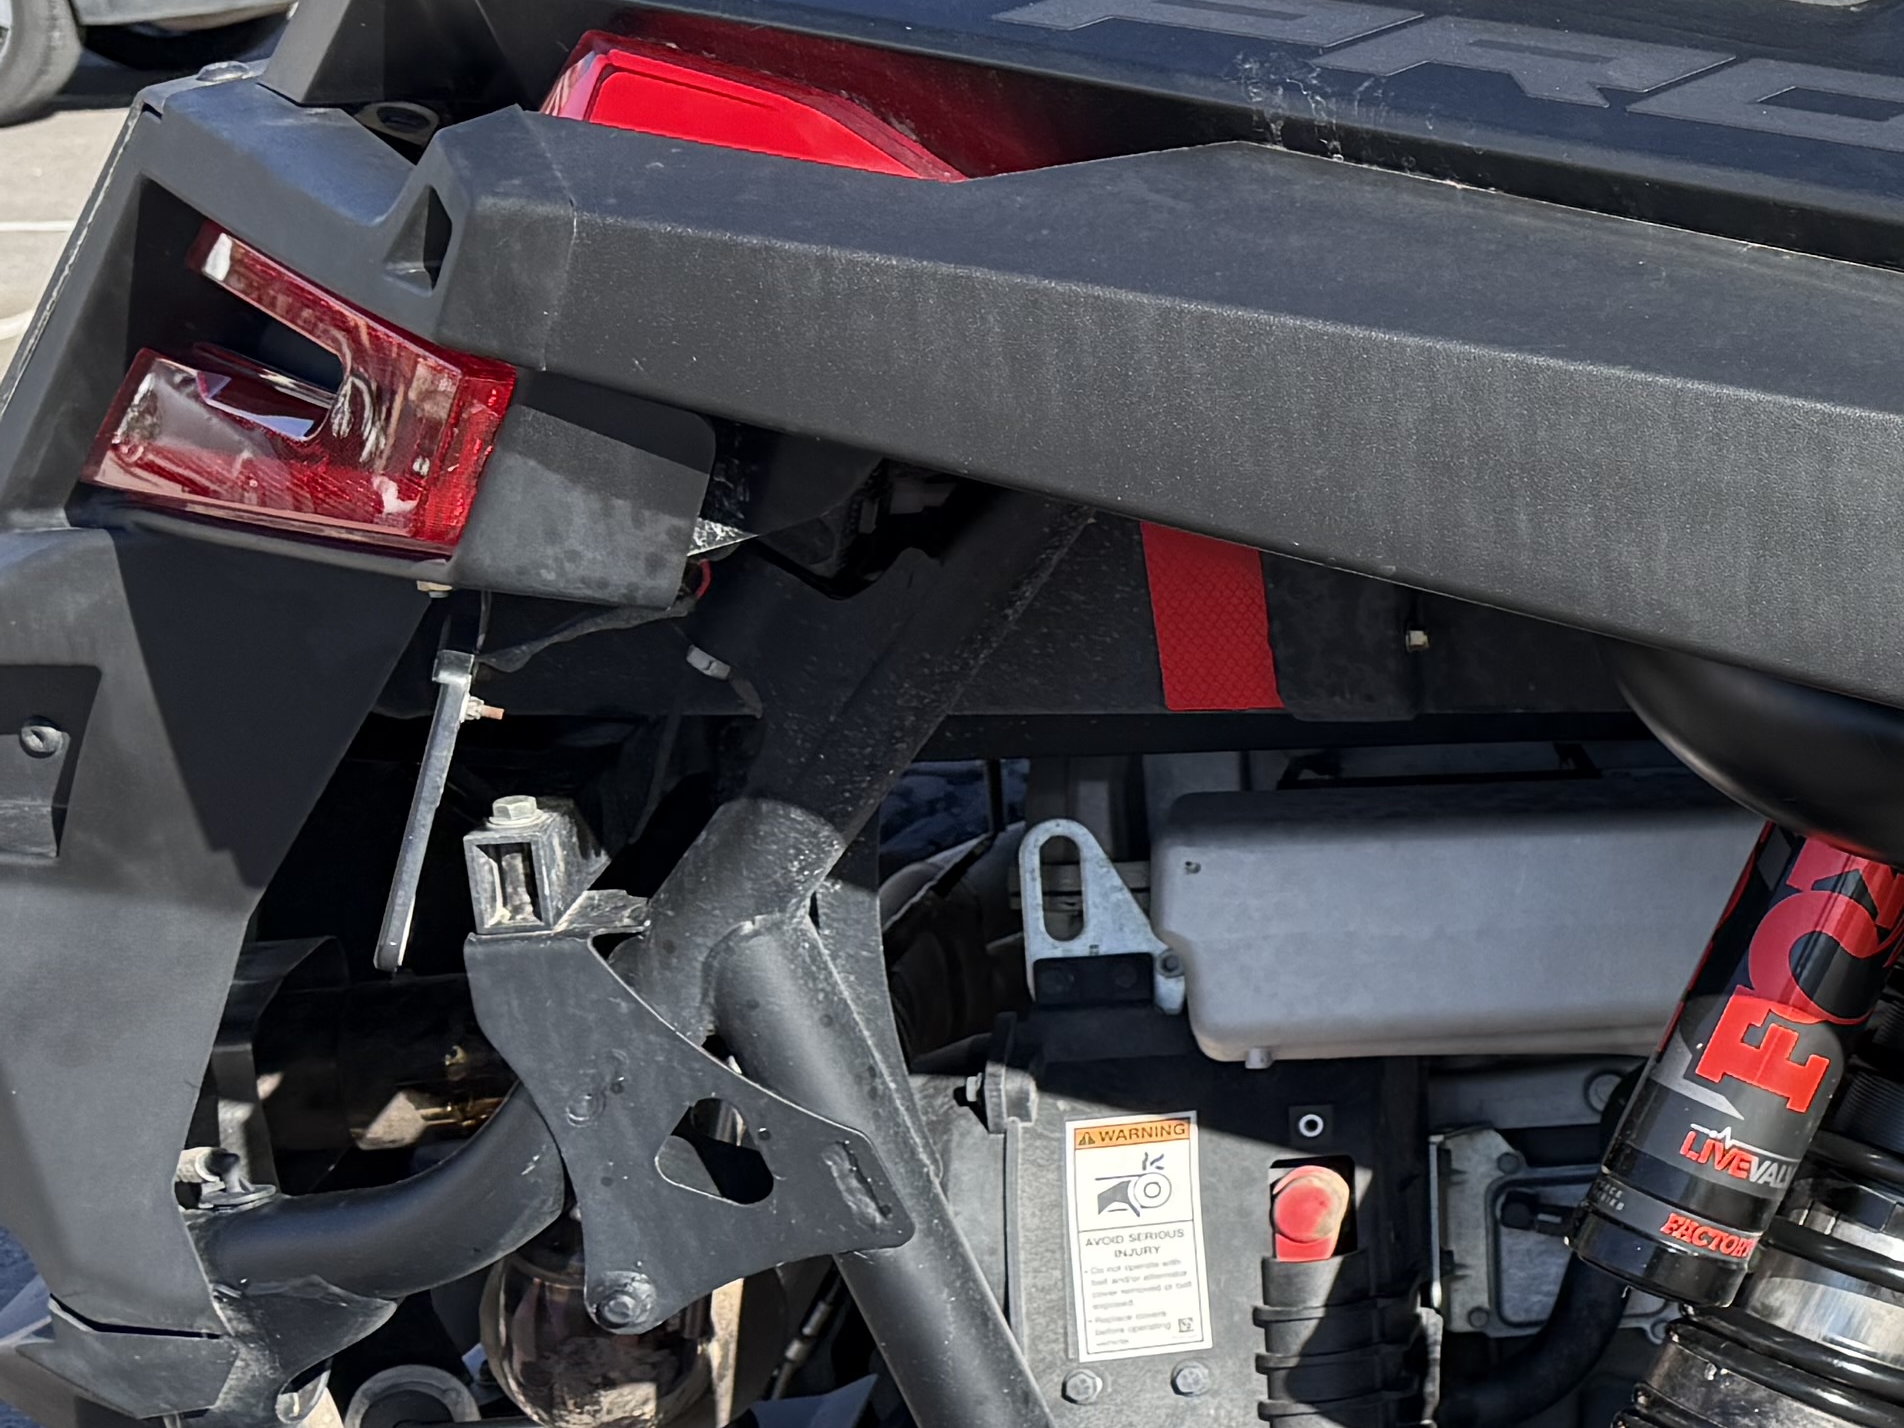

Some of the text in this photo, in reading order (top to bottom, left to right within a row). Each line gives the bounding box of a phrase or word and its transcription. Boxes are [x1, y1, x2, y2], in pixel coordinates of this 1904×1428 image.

[1098, 1123, 1186, 1143] WARNING
[1085, 1228, 1185, 1247] AVOID SERIOUS
[1114, 1245, 1161, 1258] INJURY
